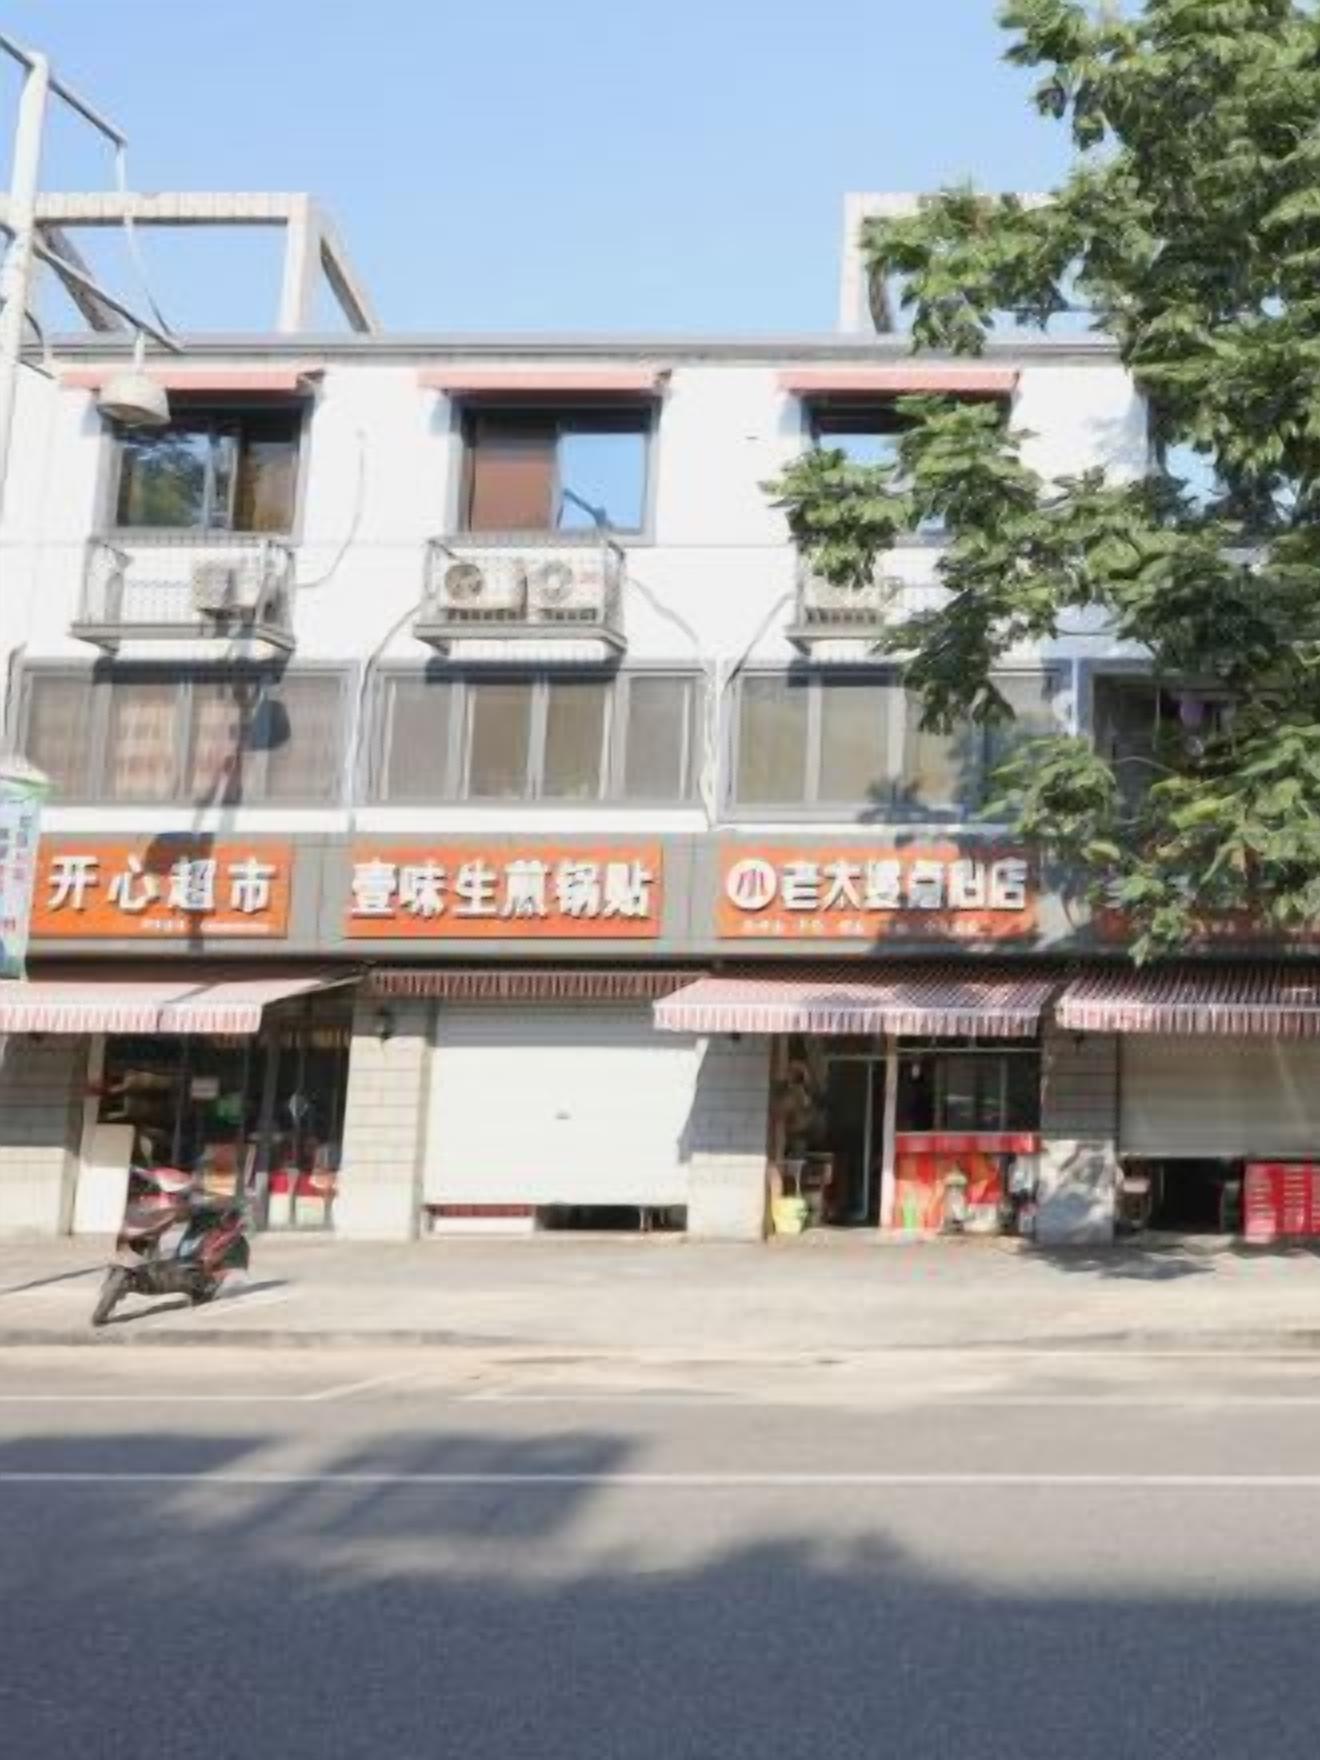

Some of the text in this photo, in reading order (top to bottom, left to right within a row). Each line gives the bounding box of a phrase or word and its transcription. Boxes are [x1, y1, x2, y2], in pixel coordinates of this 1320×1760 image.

[47, 854, 278, 913] 开心超市
[351, 857, 657, 919] 壹味生煎锅贴
